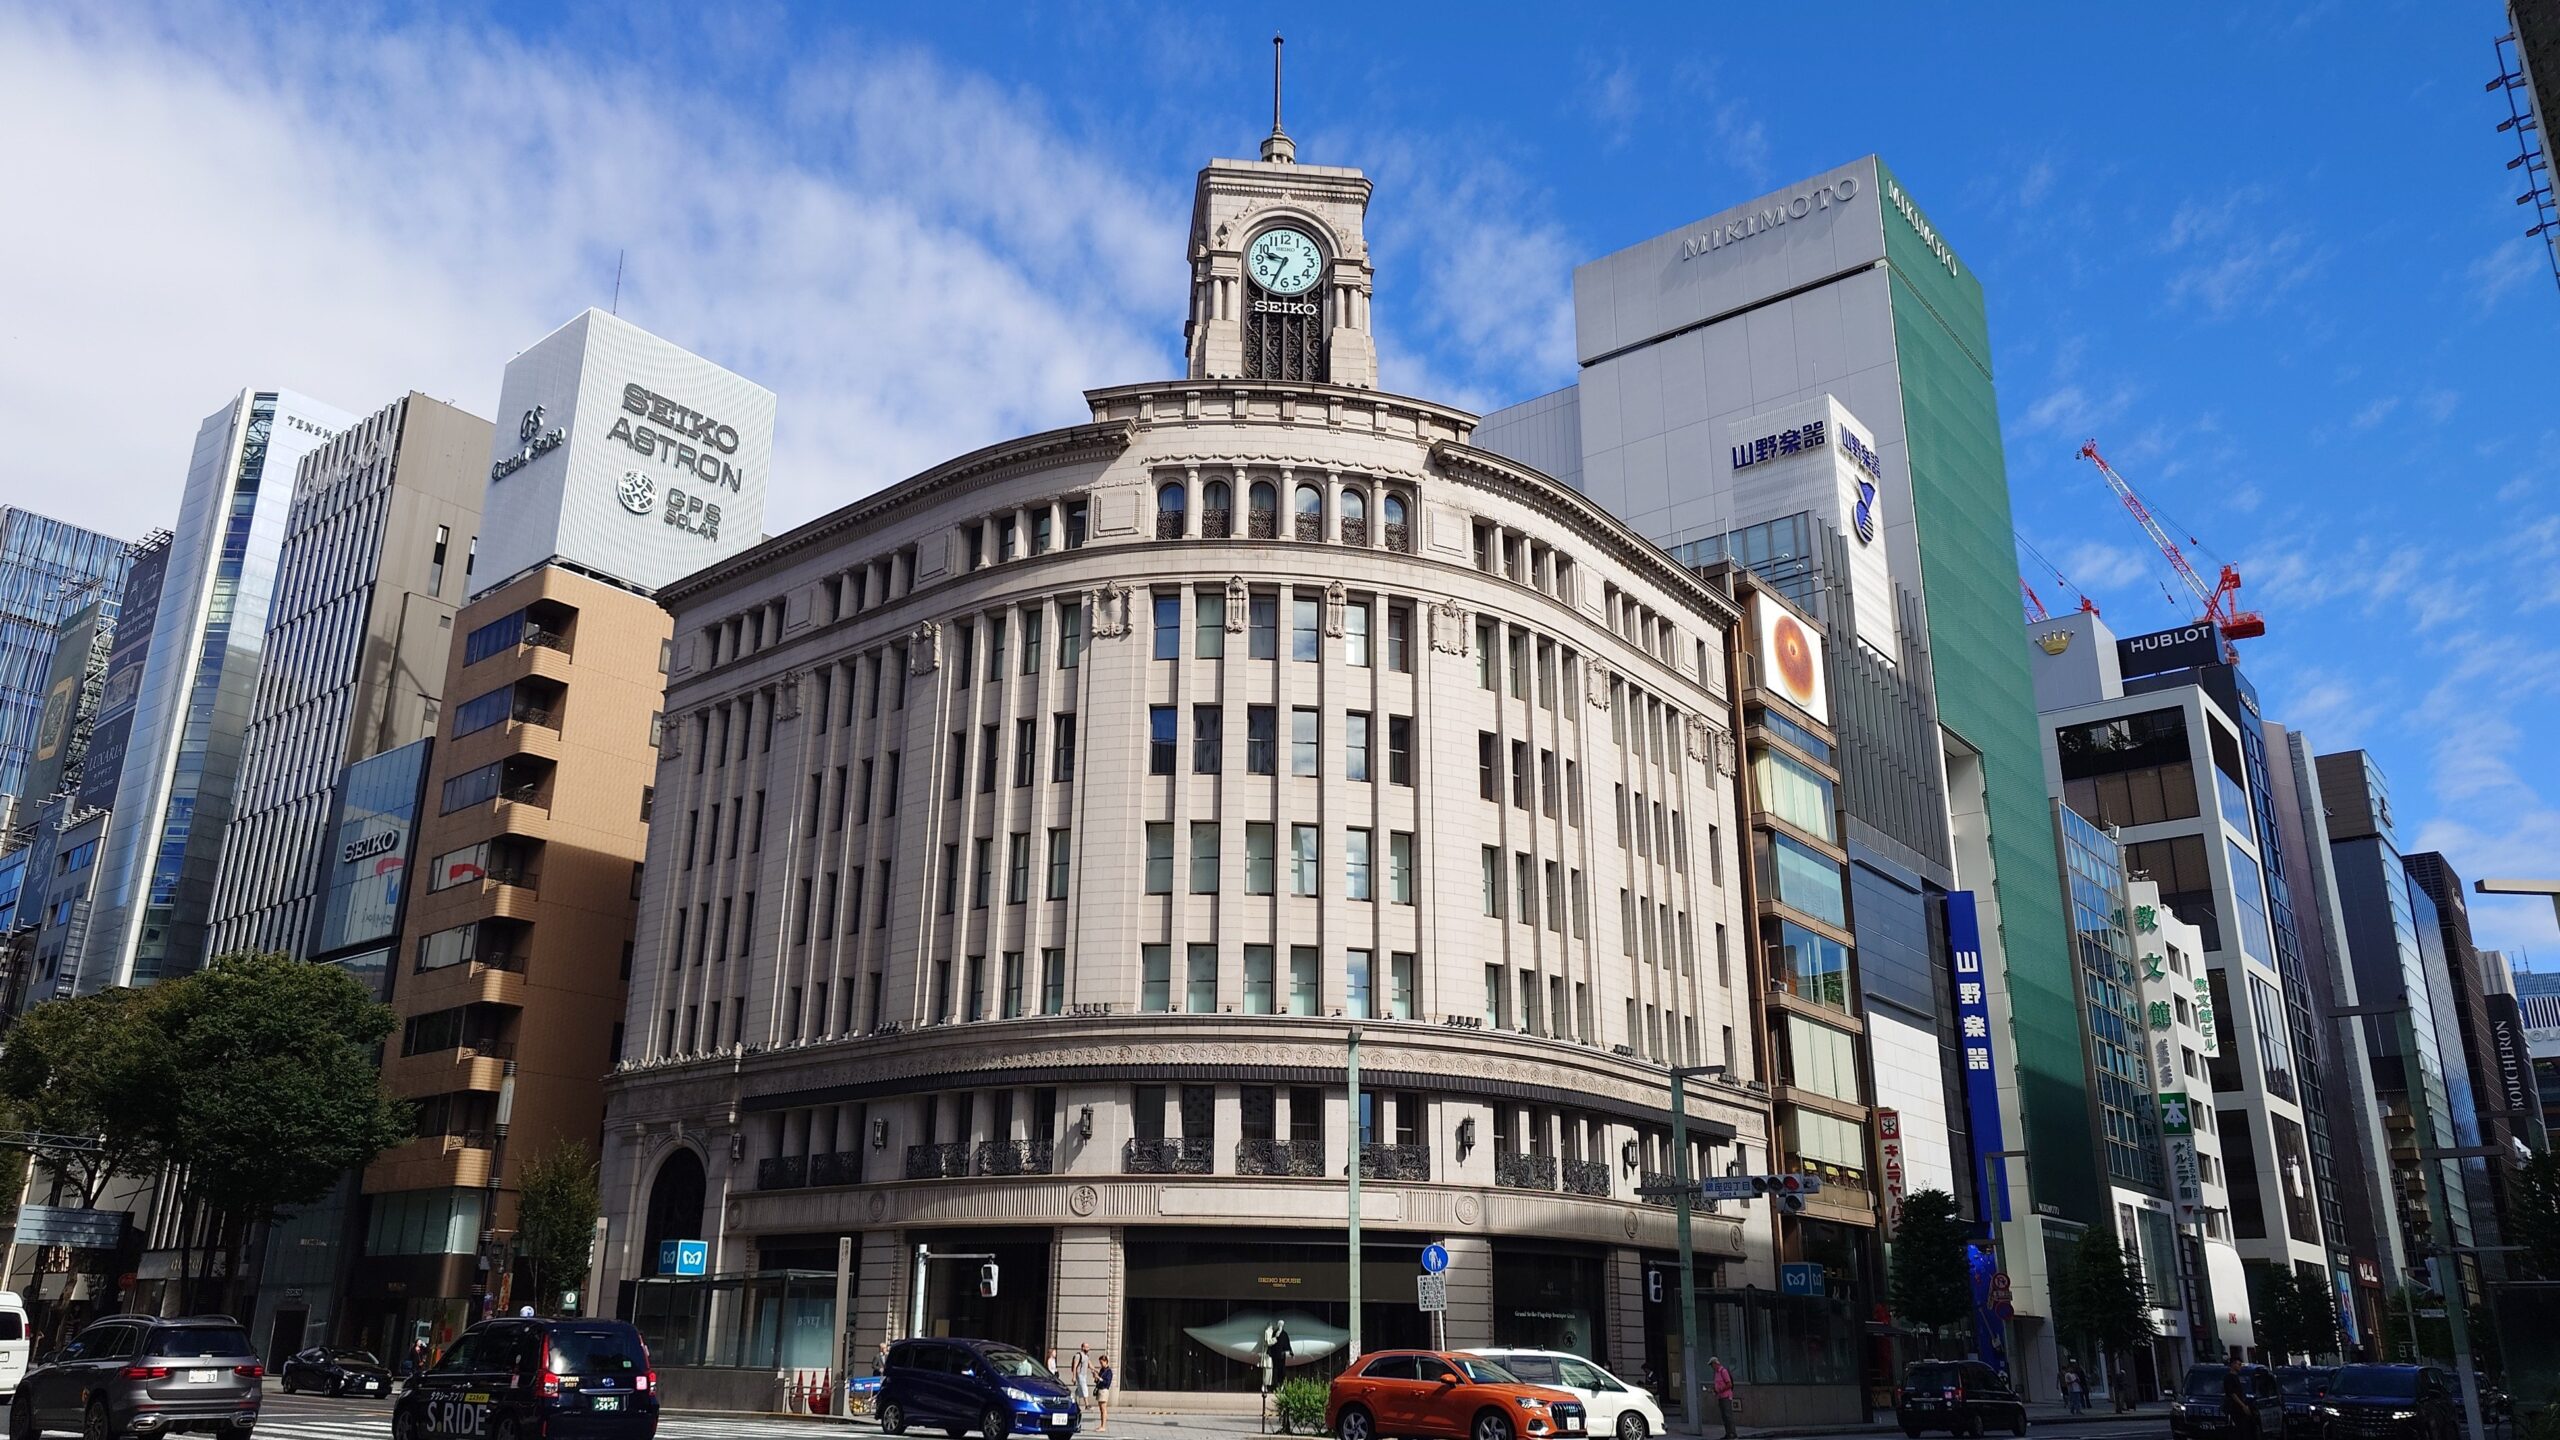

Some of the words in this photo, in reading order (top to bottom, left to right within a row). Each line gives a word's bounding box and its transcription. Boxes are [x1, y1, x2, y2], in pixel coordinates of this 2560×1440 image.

[1683, 177, 1859, 260] MIKIMOTO
[1888, 180, 1958, 277] MIKIMOTO
[1259, 244, 1269, 255] 10
[1269, 236, 1278, 246] 11
[1280, 235, 1291, 245] 12
[1296, 238, 1300, 249] 1
[1303, 247, 1312, 257] 2
[1255, 254, 1264, 265] 9
[1260, 265, 1268, 276] 8
[1301, 269, 1311, 279] 4
[1307, 258, 1315, 268] 3
[1280, 277, 1289, 288] 6
[1293, 275, 1301, 287] 5
[1254, 301, 1317, 315] SEIKO
[622, 382, 740, 455] SEIKO
[492, 446, 530, 481] Grand
[529, 426, 566, 460] Seiko
[606, 416, 743, 493] ASTRON
[1732, 420, 1826, 470] 山野楽器
[1840, 423, 1881, 479] 山野楽器
[666, 487, 722, 525] GPS
[663, 508, 720, 542] SOLAR
[2131, 626, 2211, 653] HUBLOT
[344, 830, 399, 863] SEIKO
[2133, 905, 2172, 1031] 教文館
[1956, 951, 1990, 1070] 山野楽器
[2193, 978, 2216, 1052] 教文館ビル
[2494, 1020, 2525, 1111] BOUCHERON
[2162, 1099, 2188, 1128] 本
[1705, 1181, 1750, 1192] 銀座四丁目
[430, 1391, 465, 1401] タクシーアプリ
[426, 1401, 488, 1436] S.RIDE
